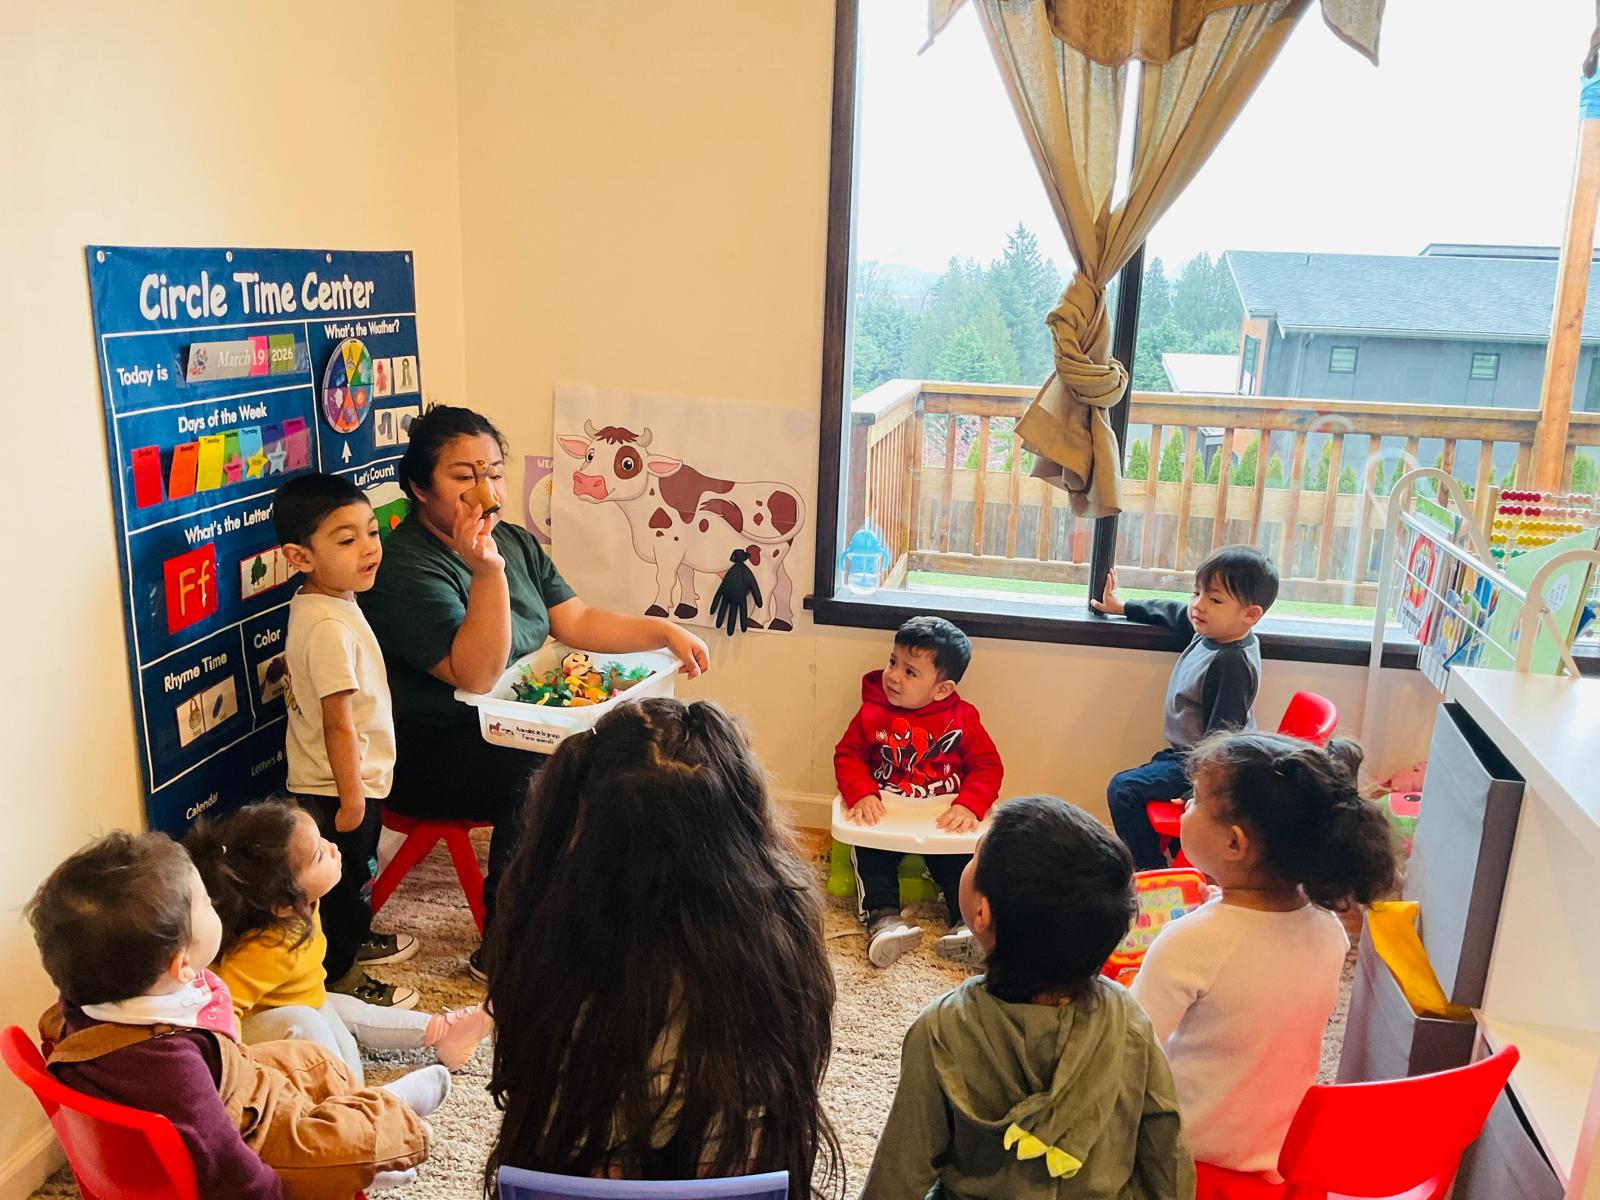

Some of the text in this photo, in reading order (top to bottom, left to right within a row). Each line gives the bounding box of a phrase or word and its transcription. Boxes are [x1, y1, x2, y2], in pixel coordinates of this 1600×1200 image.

[139, 270, 375, 321] Circle Time Center
[324, 319, 400, 340] What's the Weather?
[217, 347, 294, 369] March 19 2026
[116, 363, 169, 387] Today is
[178, 401, 267, 434] Days of the Week
[354, 464, 395, 487] Let's Count
[184, 520, 223, 545] What's
[224, 515, 241, 533] the
[178, 559, 211, 617] Ff
[253, 628, 281, 648] Color
[163, 653, 228, 693] Rhyme Time
[186, 792, 219, 820] Calendar
